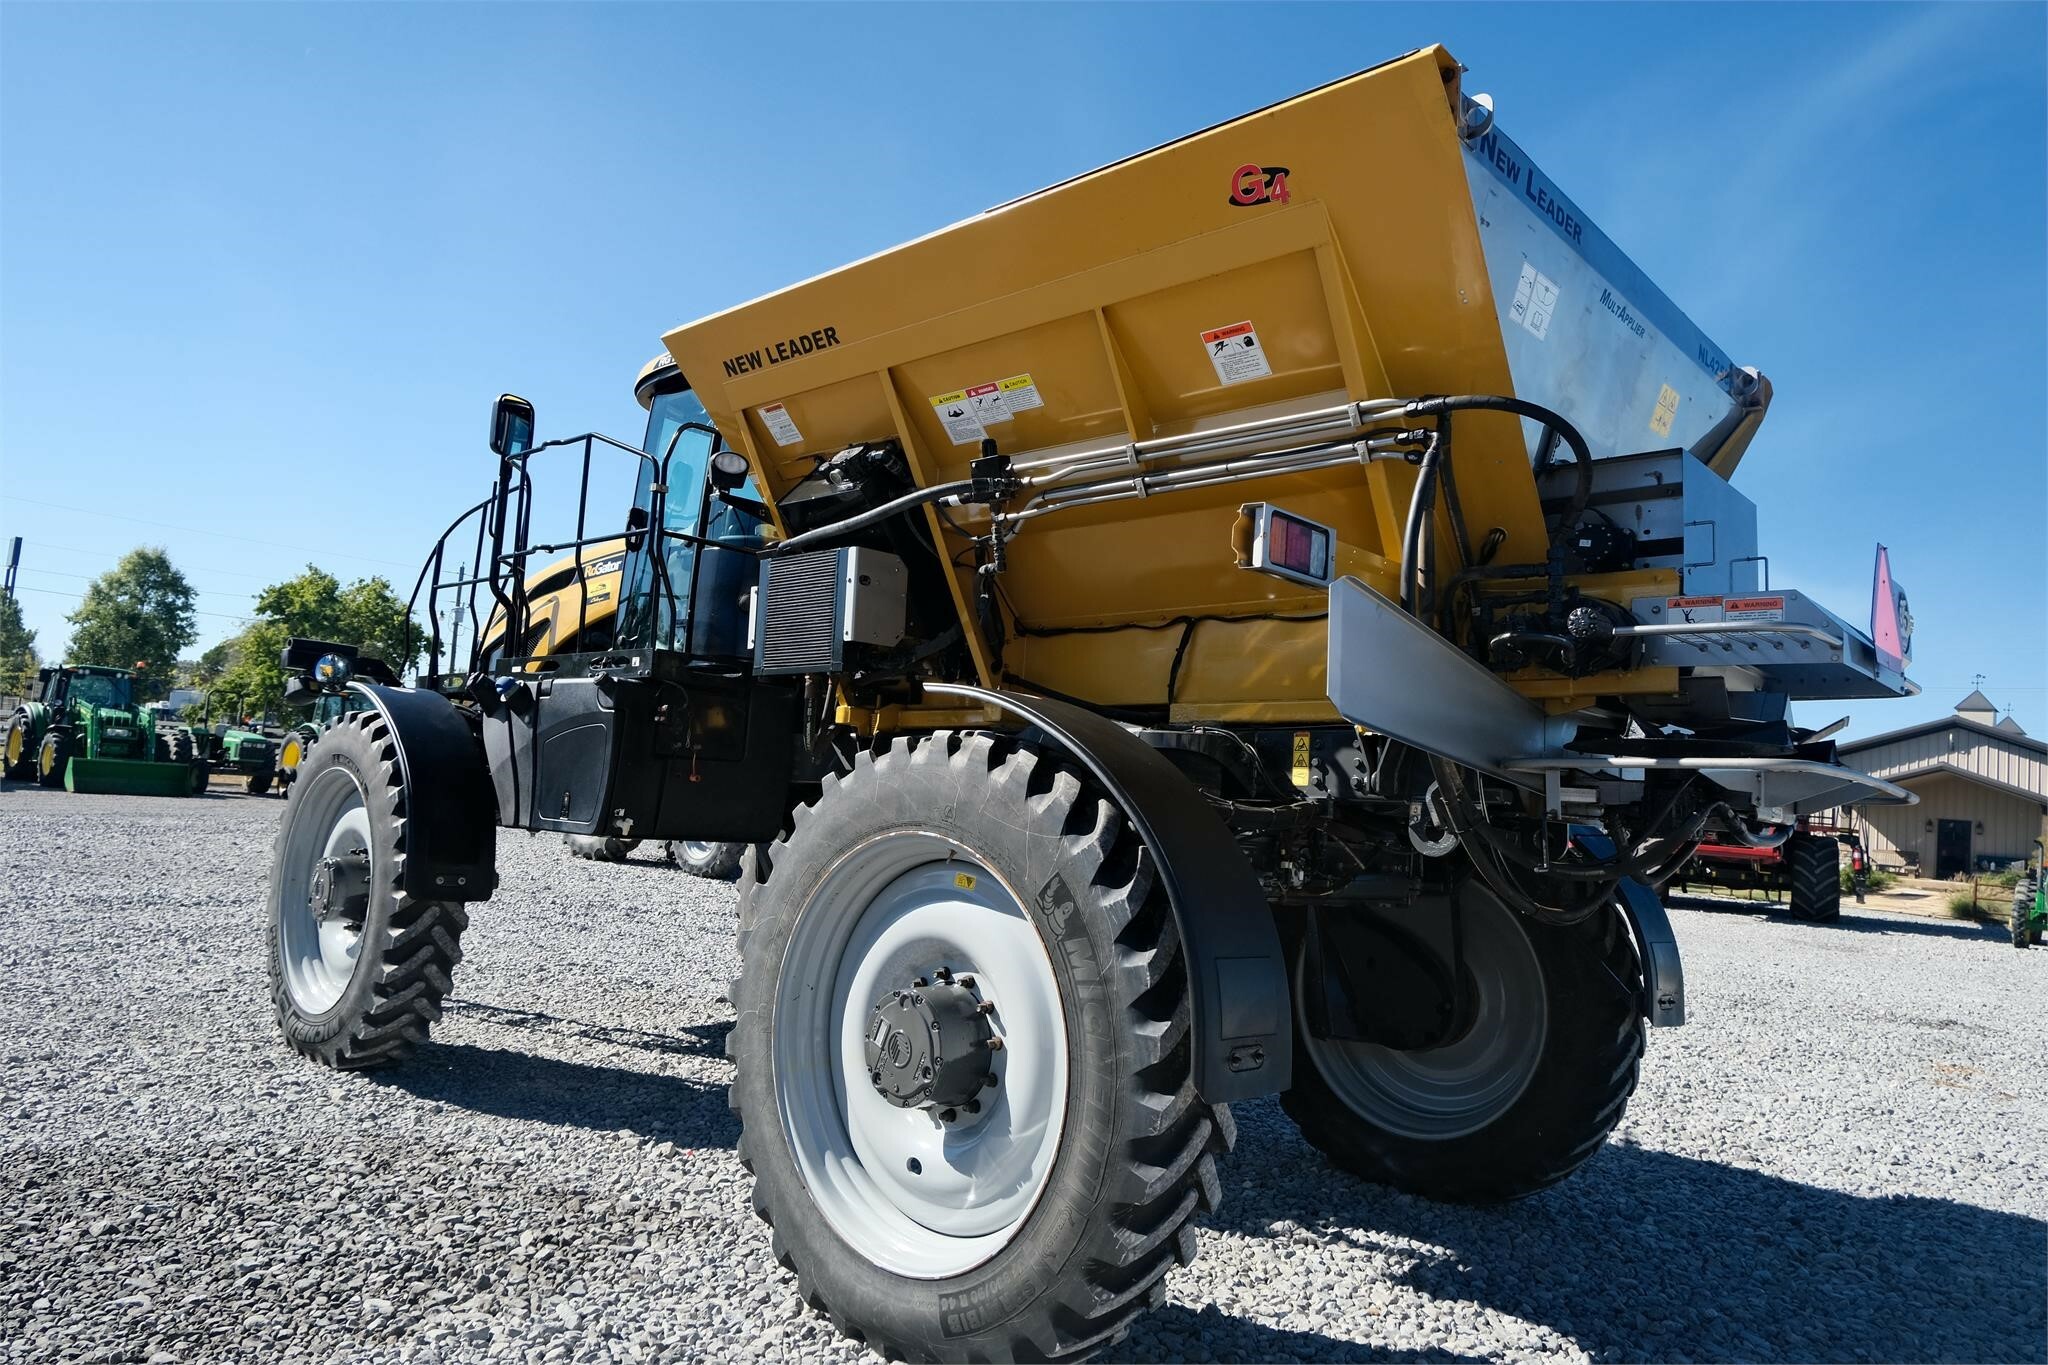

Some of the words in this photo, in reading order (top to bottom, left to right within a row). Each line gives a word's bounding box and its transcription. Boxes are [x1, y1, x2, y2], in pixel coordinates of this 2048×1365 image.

[1231, 163, 1290, 206] G4
[1479, 132, 1521, 185] NEW
[1525, 167, 1583, 246] LEADER
[722, 349, 763, 377] NEW
[765, 326, 840, 365] LEADER
[1009, 378, 1028, 387] CAUTION
[943, 394, 961, 403] CAUTION
[585, 560, 623, 577] RoGator
